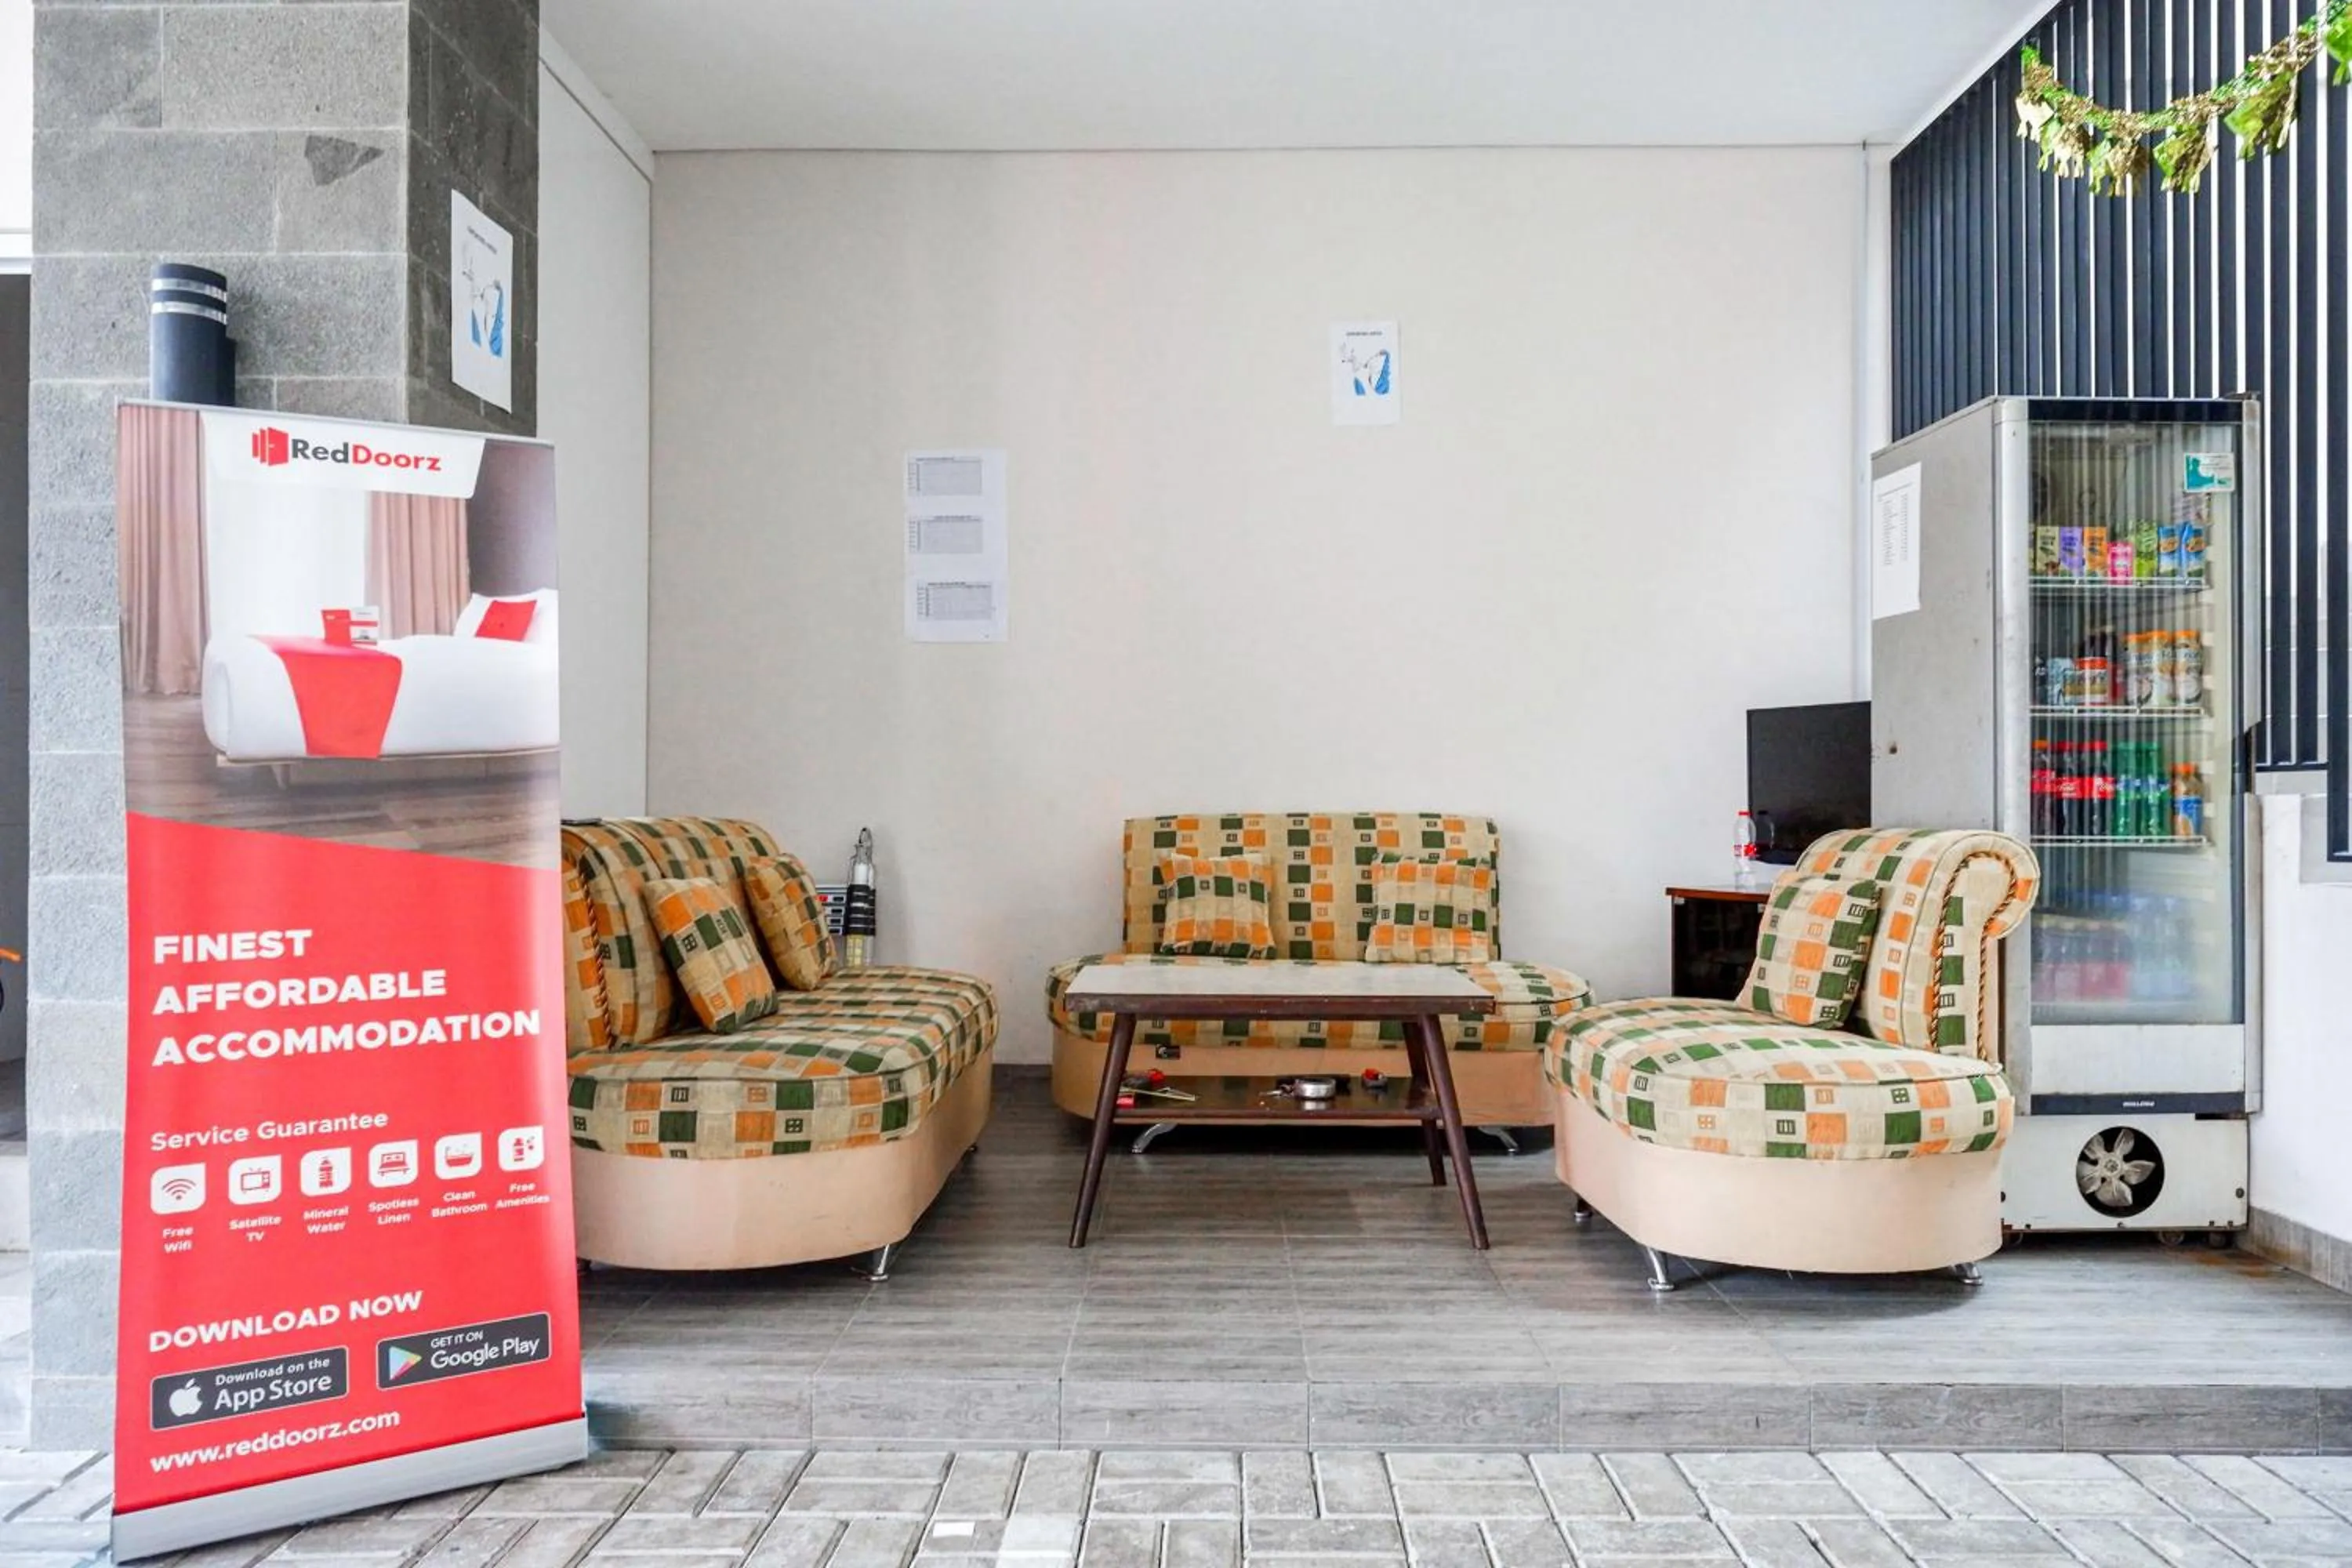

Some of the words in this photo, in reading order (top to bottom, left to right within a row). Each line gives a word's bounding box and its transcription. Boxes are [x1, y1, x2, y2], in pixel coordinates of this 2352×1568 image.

[292, 438, 441, 471] RedDoorz
[153, 929, 312, 964] FINEST
[152, 970, 446, 1014] AFFORDABLE
[152, 1010, 540, 1066] ACCOMMODATION
[151, 1126, 249, 1151] Service
[257, 1112, 389, 1139] Guarantee
[510, 1182, 535, 1192] Free
[443, 1190, 476, 1202] Clean
[495, 1195, 550, 1209] Amenities
[303, 1206, 349, 1220] Mineral
[368, 1198, 419, 1214] Spotless
[432, 1203, 488, 1218] Bathroom
[229, 1215, 281, 1230] Satellite
[377, 1213, 411, 1225] Linen
[162, 1226, 194, 1239] Free
[307, 1221, 346, 1234] Water
[247, 1231, 265, 1242] TV
[164, 1240, 192, 1253] Wifi
[149, 1305, 340, 1352] DOWNLOAD
[349, 1290, 423, 1320] NOW
[430, 1334, 454, 1348] GET
[455, 1333, 464, 1344] IT
[466, 1330, 484, 1342] ON
[430, 1342, 499, 1369] Google
[503, 1337, 540, 1356] Play
[215, 1365, 283, 1386] Download
[287, 1363, 305, 1374] on
[308, 1357, 330, 1370] the
[214, 1387, 266, 1412] App
[269, 1374, 332, 1400] Store
[150, 1410, 401, 1473] www.reddoorz.com
